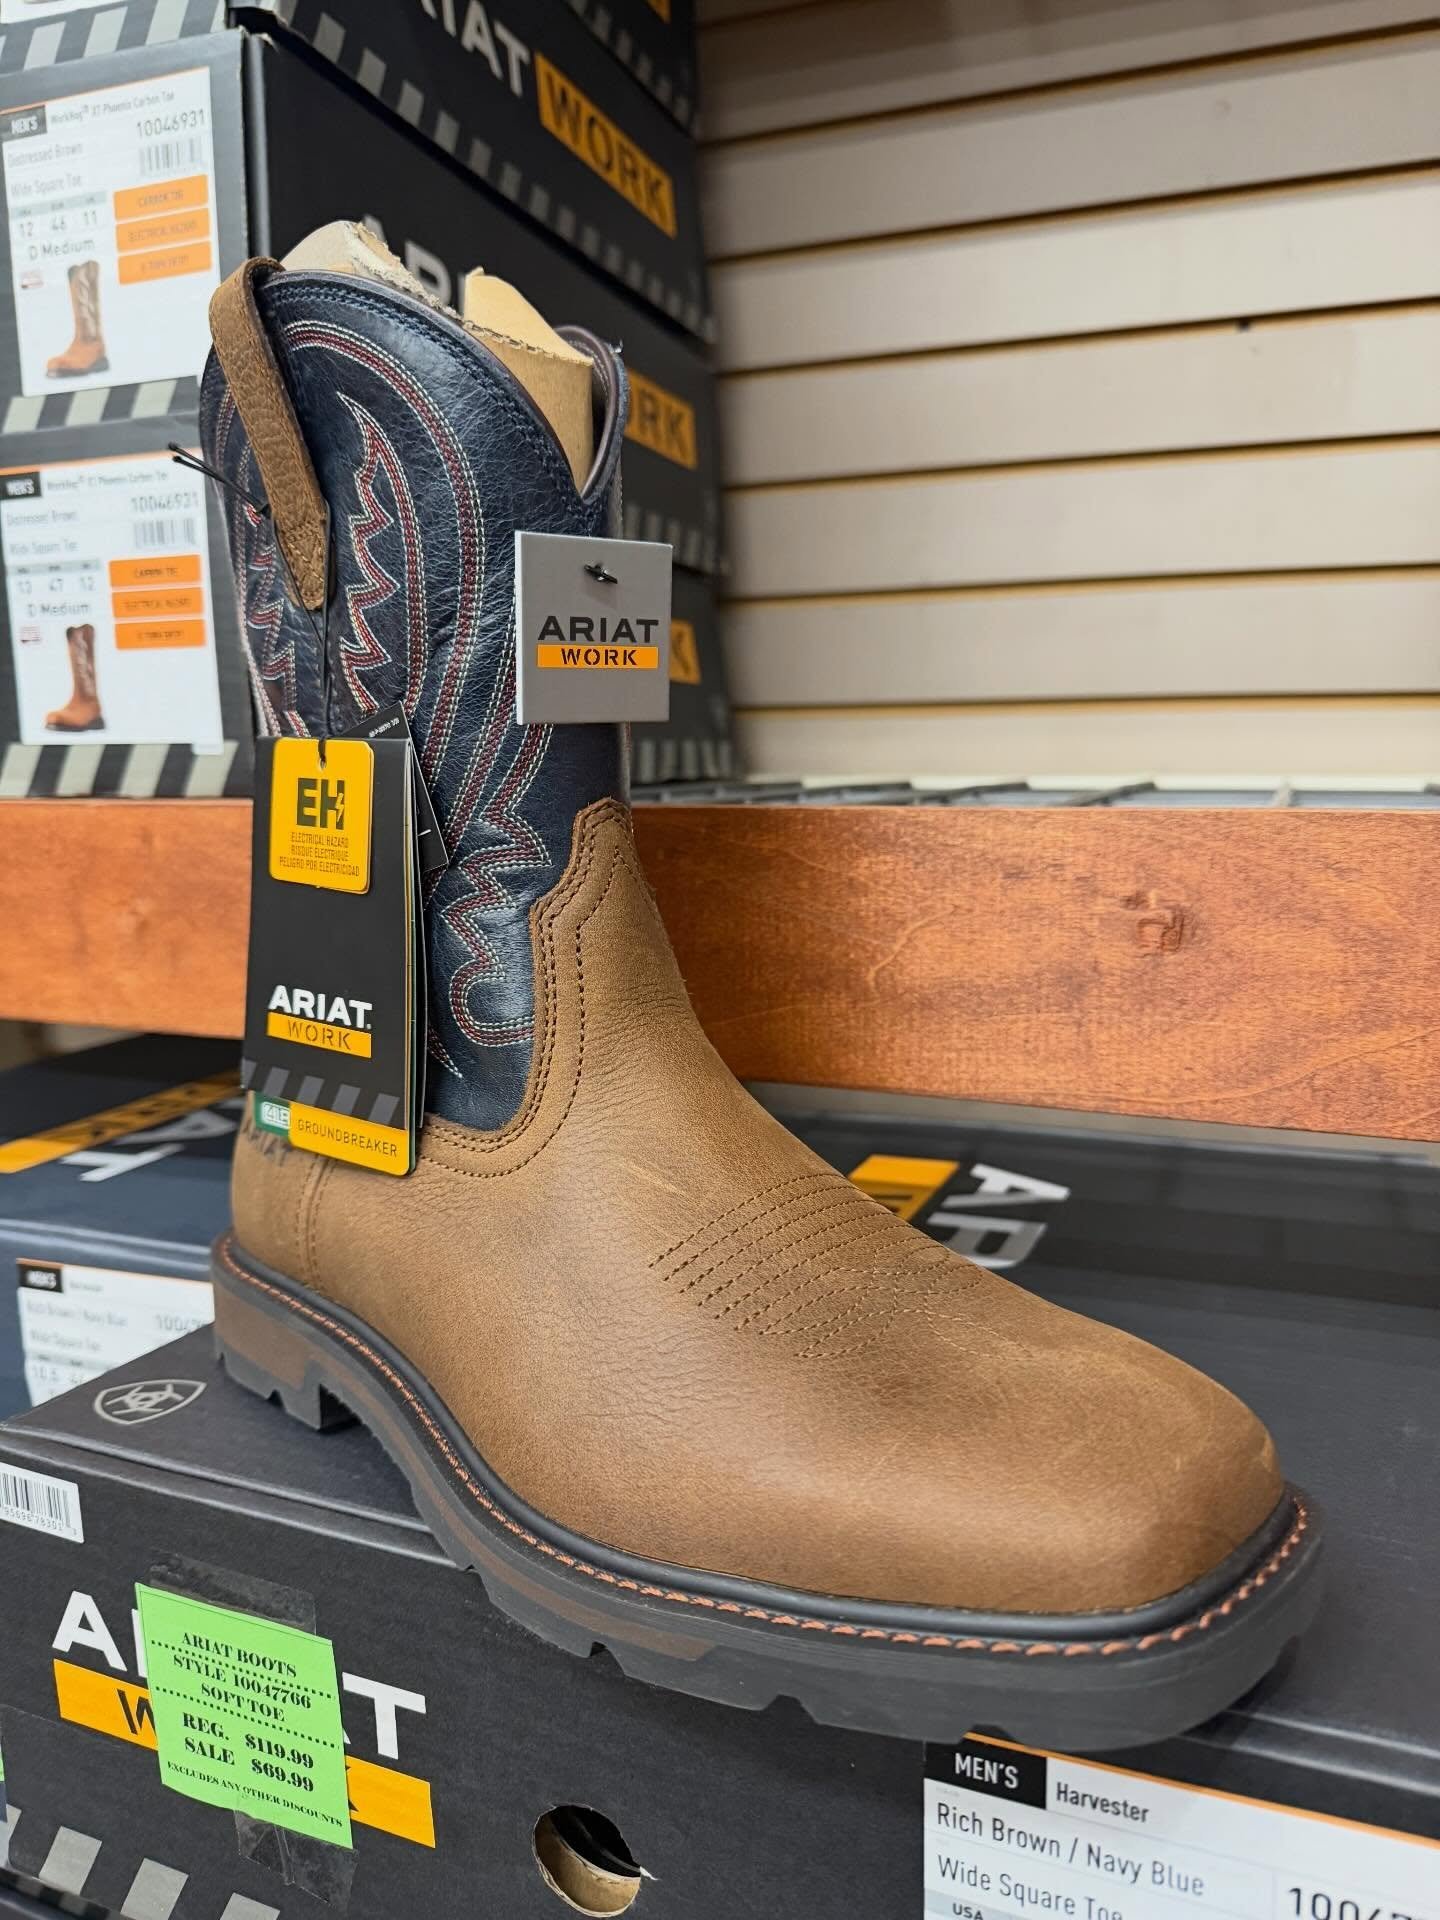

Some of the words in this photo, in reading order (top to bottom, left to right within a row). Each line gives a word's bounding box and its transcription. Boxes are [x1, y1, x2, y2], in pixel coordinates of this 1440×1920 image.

[136, 109, 206, 138] 10046931
[546, 72, 669, 233] WORK
[29, 245, 38, 260] D
[43, 239, 95, 257] Medium
[538, 615, 659, 643] ARIAT
[561, 648, 638, 666] WORK
[291, 832, 326, 846] ELECTRICAL
[287, 1019, 351, 1050] WORK
[298, 1119, 397, 1157] GROUNDBREAKER
[181, 1632, 233, 1658] ARIAT
[237, 1650, 297, 1678] BOOTS
[173, 1654, 226, 1683] STYLE
[233, 1671, 311, 1709] 10047766
[201, 1683, 245, 1710] SOFT
[246, 1697, 286, 1722] TOE
[182, 1712, 230, 1741] REG.
[244, 1733, 314, 1769] $119.99
[184, 1736, 235, 1766] SALE
[251, 1758, 314, 1792] $69.99
[167, 1761, 219, 1785] EXCLUDES
[220, 1777, 241, 1792] ANY
[243, 1785, 280, 1805] OTHER
[282, 1798, 343, 1828] DISCOUNTS
[955, 1752, 1019, 1789] MEN'S
[1056, 1781, 1149, 1823] Harvester
[938, 1802, 983, 1837] Rich
[992, 1818, 1060, 1858] Brown
[1069, 1837, 1079, 1864] /
[1087, 1843, 1142, 1884] Navy
[1152, 1861, 1205, 1896] Blue
[938, 1854, 991, 1891] Wide
[999, 1873, 1076, 1915] Square
[952, 1903, 985, 1920] USA
